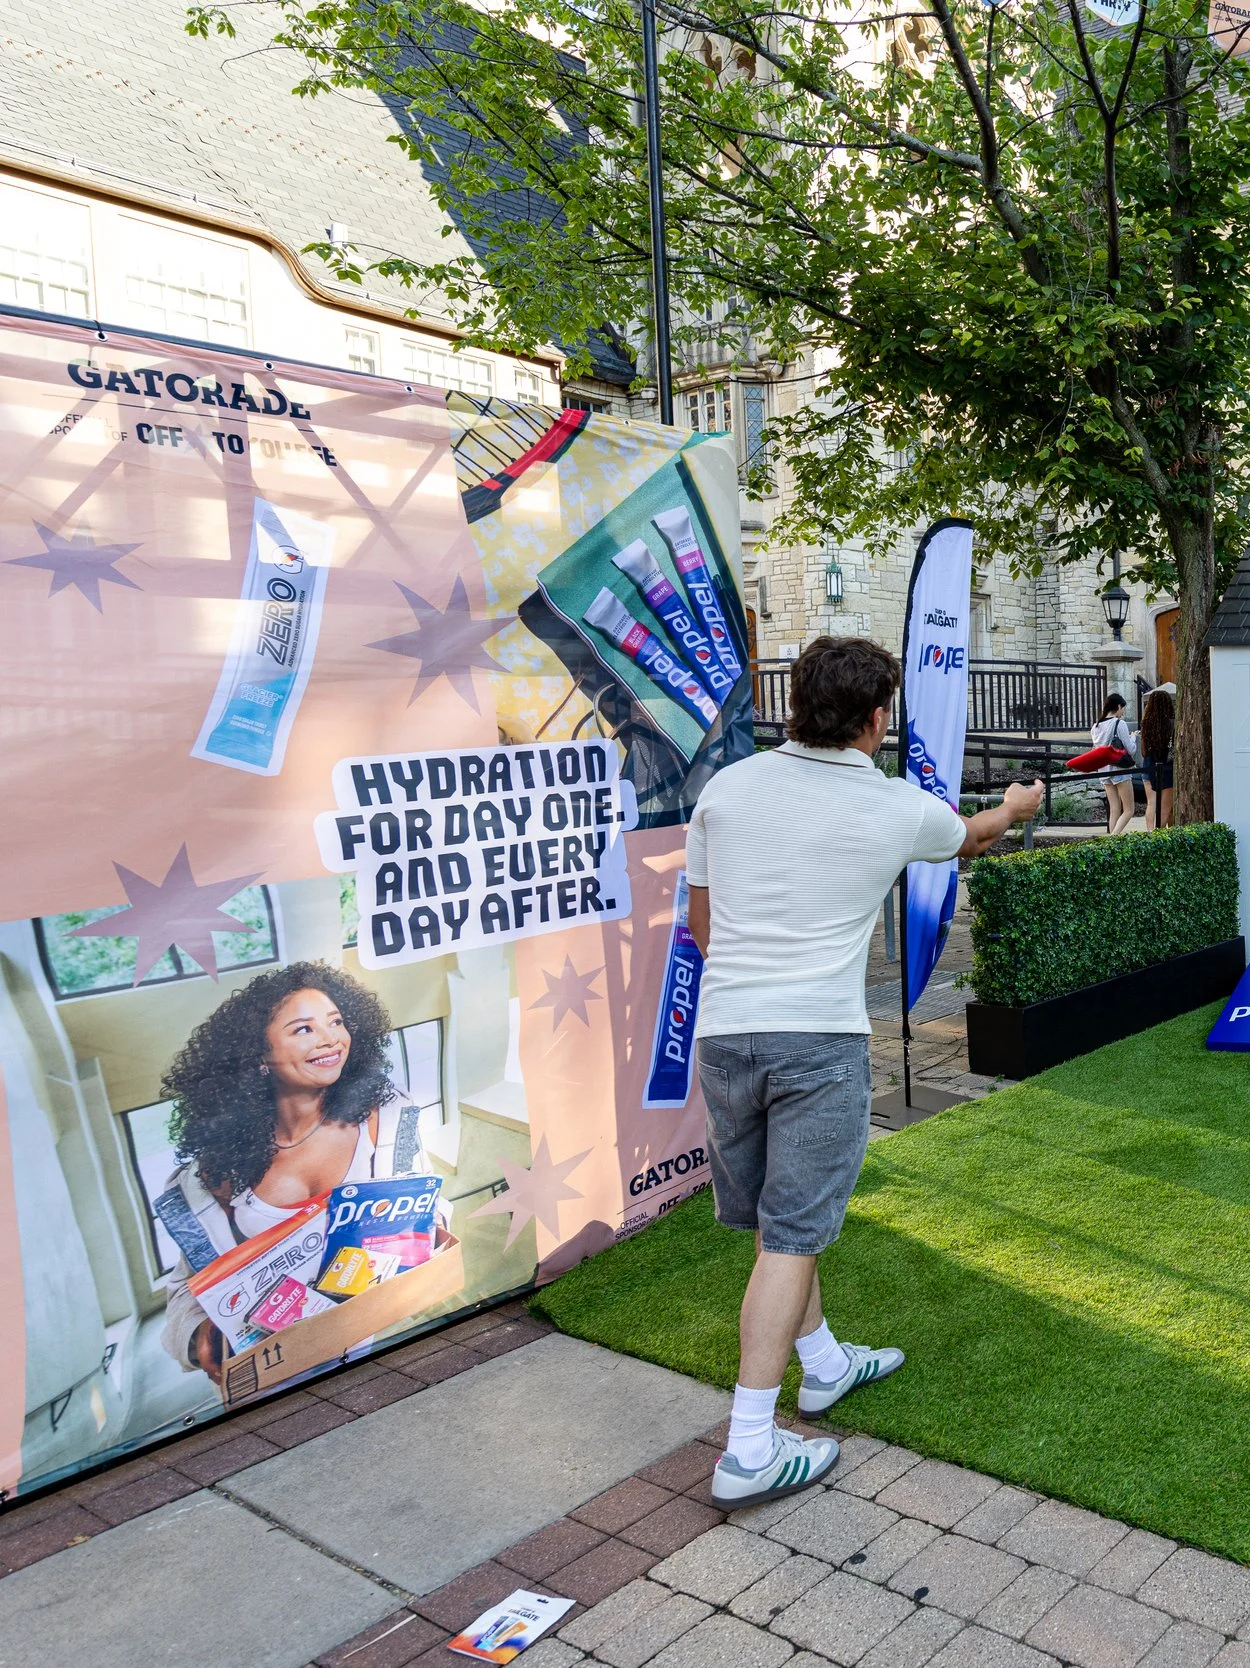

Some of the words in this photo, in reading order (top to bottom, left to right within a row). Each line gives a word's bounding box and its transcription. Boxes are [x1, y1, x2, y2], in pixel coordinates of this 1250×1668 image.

[67, 358, 312, 421] GATORADE
[136, 422, 183, 448] OFF
[212, 431, 245, 454] TO
[682, 555, 700, 568] BERRY
[651, 585, 669, 602] GRAPE
[257, 577, 297, 667] ZERO
[628, 628, 642, 645] BLACK
[632, 631, 646, 650] CHERRY
[687, 577, 741, 669] propel
[288, 641, 298, 668] ADVANCED
[663, 605, 732, 690] propel
[240, 693, 274, 708] FREEZE
[645, 645, 719, 721] propel
[350, 745, 607, 807] HYDRATION
[335, 808, 433, 860] FOR
[444, 796, 532, 846] DAY
[542, 787, 626, 832] ONE.
[375, 851, 472, 906] AND
[371, 898, 470, 957] DAY
[480, 876, 617, 935] AFTER.
[665, 956, 695, 1064] propel
[425, 1179, 437, 1187] 32
[328, 1187, 440, 1235] propel
[620, 1211, 649, 1230] OFFICIAL
[251, 1231, 324, 1294] ZERO
[336, 1251, 363, 1289] GATORLYTE
[268, 1286, 303, 1324] GATORLYTE
[269, 1292, 283, 1306] G
